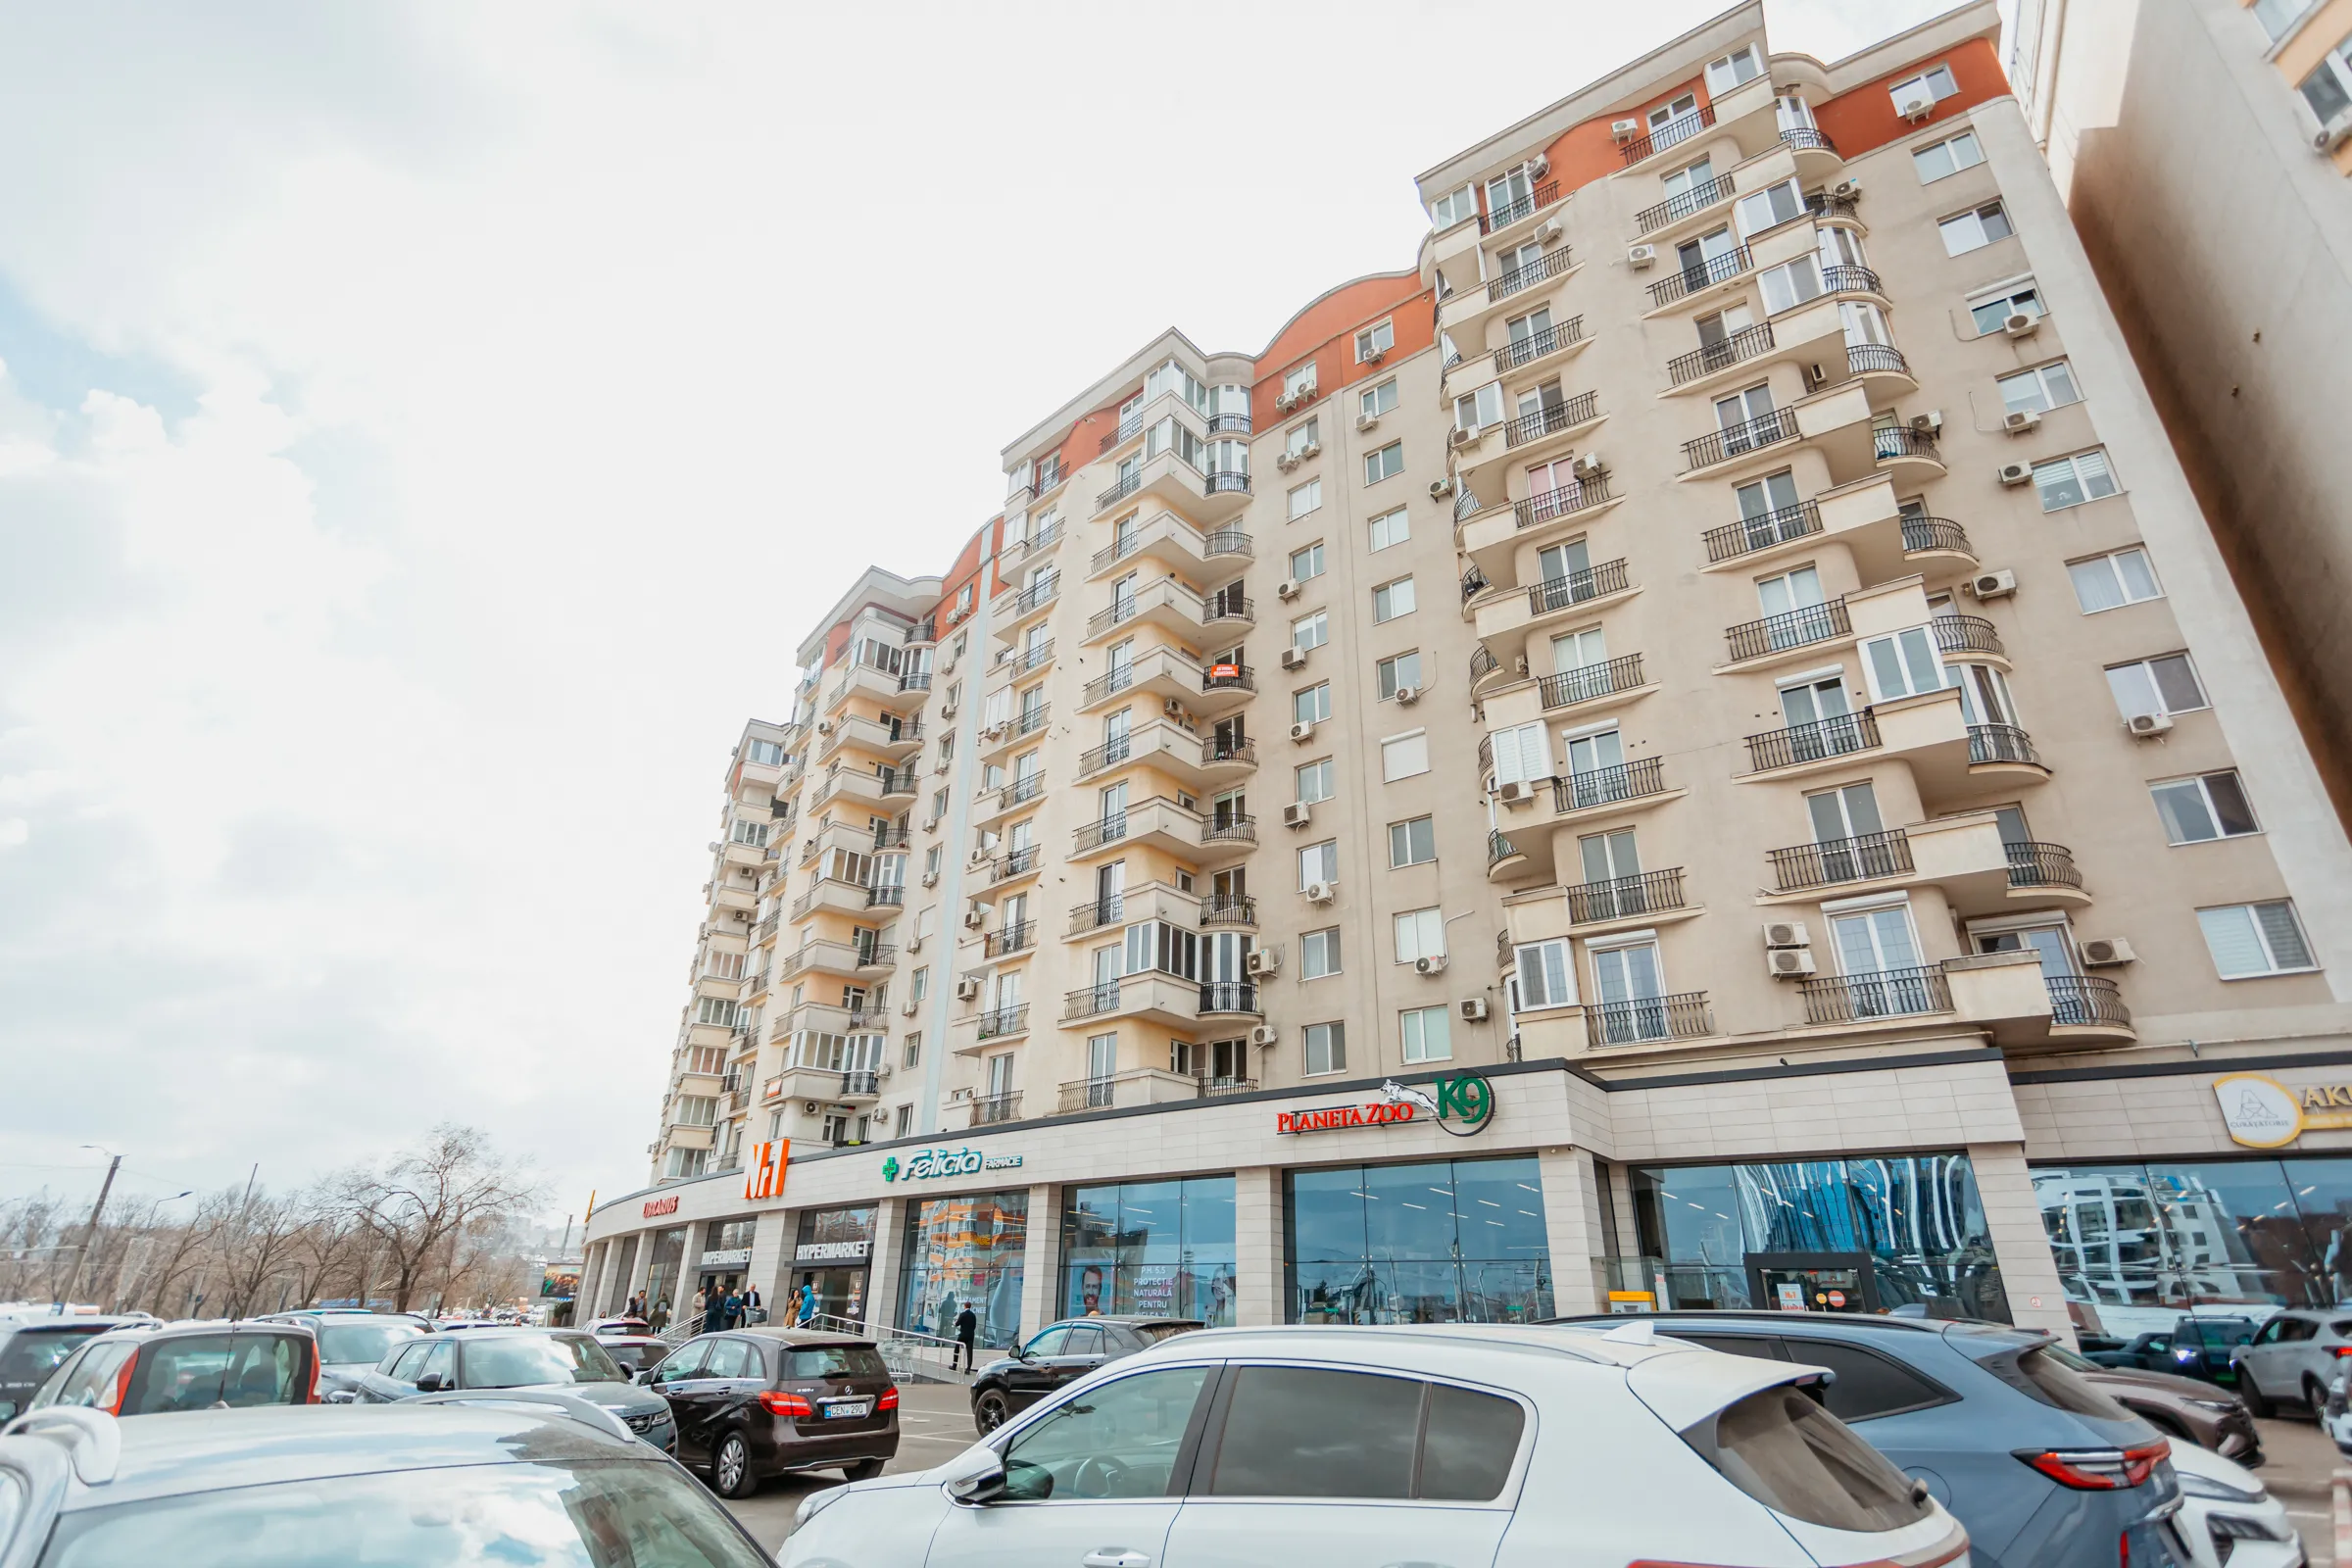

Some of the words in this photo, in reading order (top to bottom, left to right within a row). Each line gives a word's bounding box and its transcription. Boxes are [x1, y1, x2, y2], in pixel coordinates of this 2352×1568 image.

[1434, 1075, 1489, 1124] K9
[1276, 1109, 1363, 1132] PLANETA
[1365, 1102, 1414, 1125] ZOO
[901, 1147, 983, 1181] Felicia
[985, 1155, 1022, 1170] FARMACIE
[702, 1249, 752, 1265] HYPERMARKET
[796, 1240, 870, 1260] HYPERMARKET
[1133, 1287, 1173, 1297] NATURALĂ
[851, 1404, 863, 1414] 290
